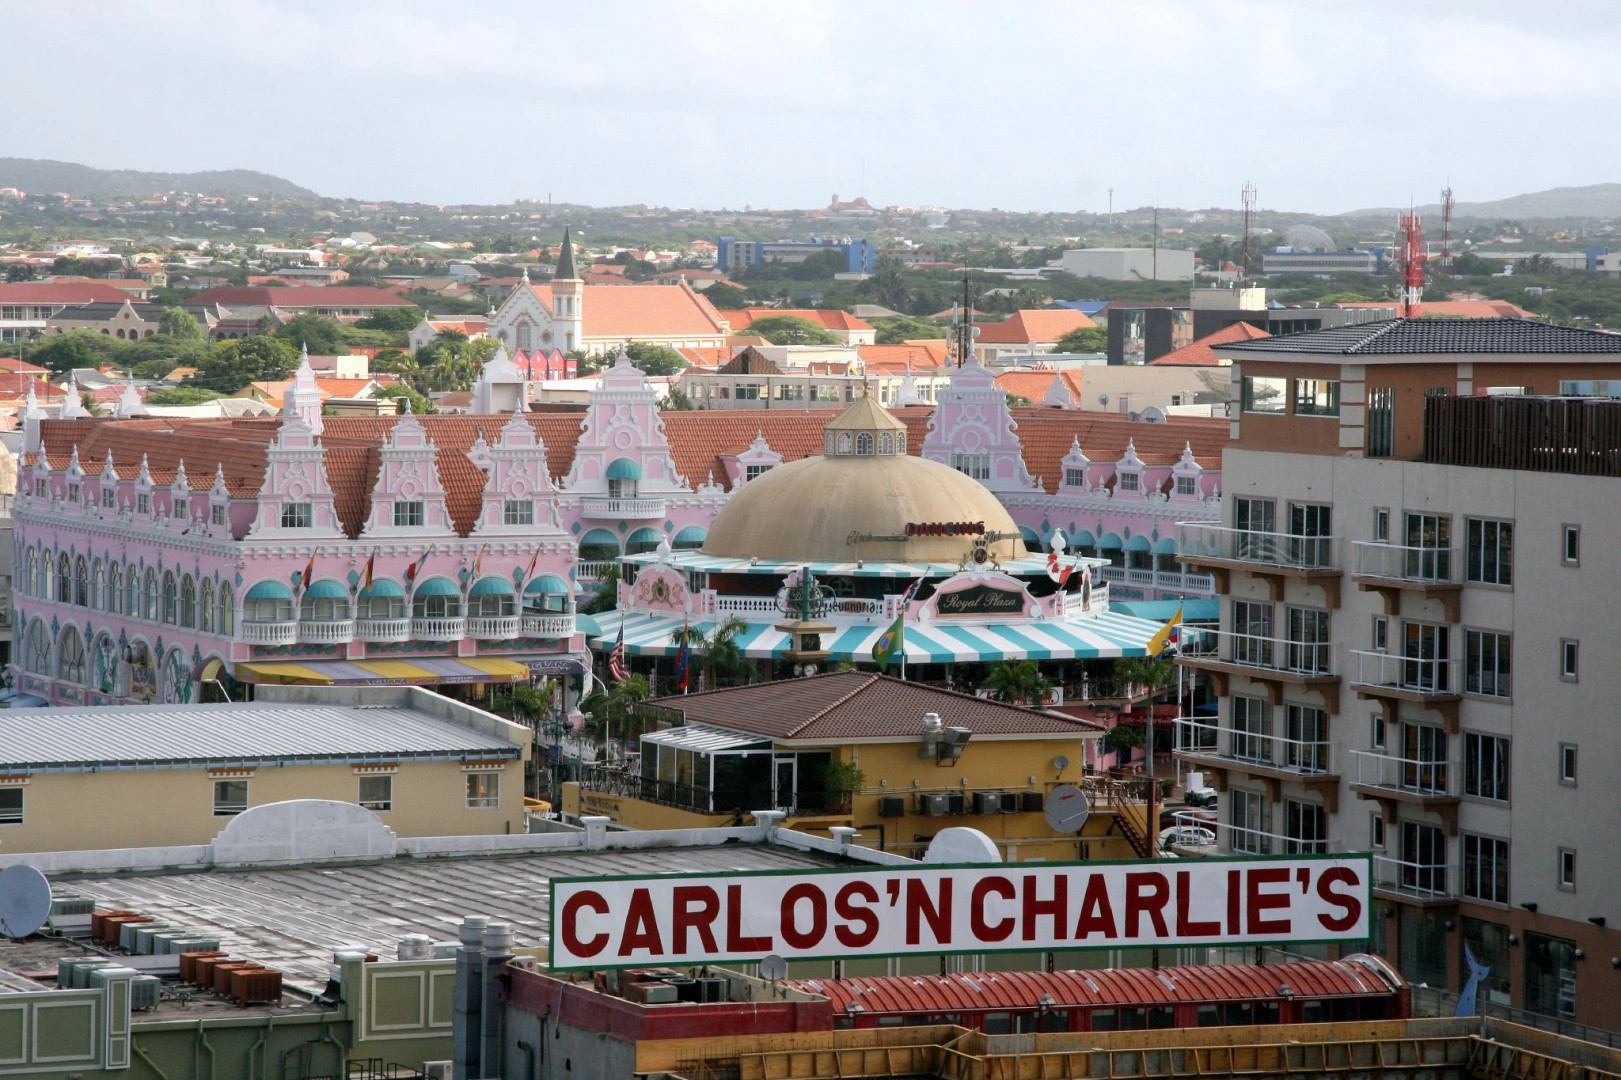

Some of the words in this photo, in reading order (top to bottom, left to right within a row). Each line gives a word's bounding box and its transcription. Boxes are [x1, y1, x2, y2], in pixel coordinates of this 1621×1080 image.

[906, 521, 985, 536] DANCING
[943, 593, 985, 612] Royal
[983, 592, 1016, 607] Plaza
[970, 866, 1362, 943] CHARLIE'S
